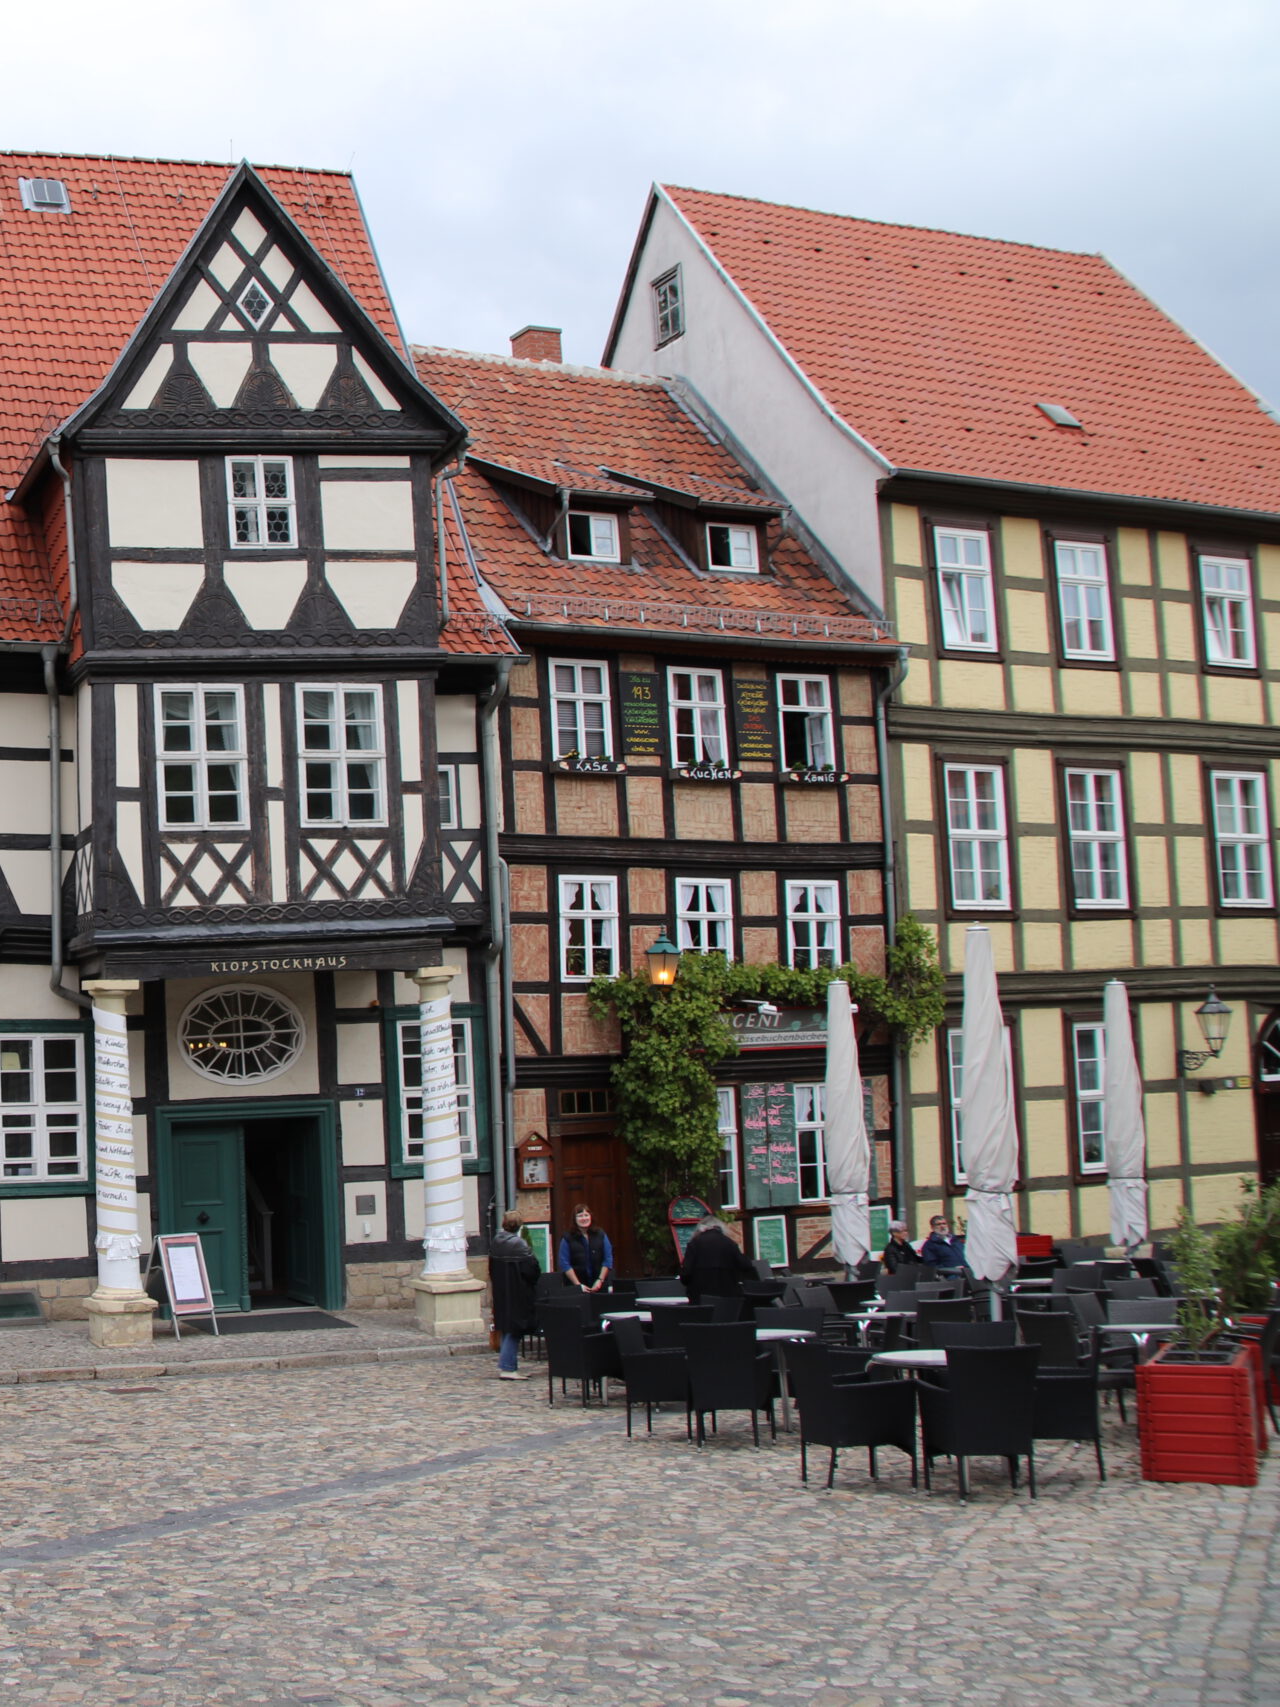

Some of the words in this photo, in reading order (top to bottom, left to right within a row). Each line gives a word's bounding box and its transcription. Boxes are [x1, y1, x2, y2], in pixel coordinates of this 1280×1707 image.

[632, 686, 652, 700] 193
[210, 955, 347, 973] KLOPSTOCKHAUS
[720, 1012, 783, 1028] NCENT
